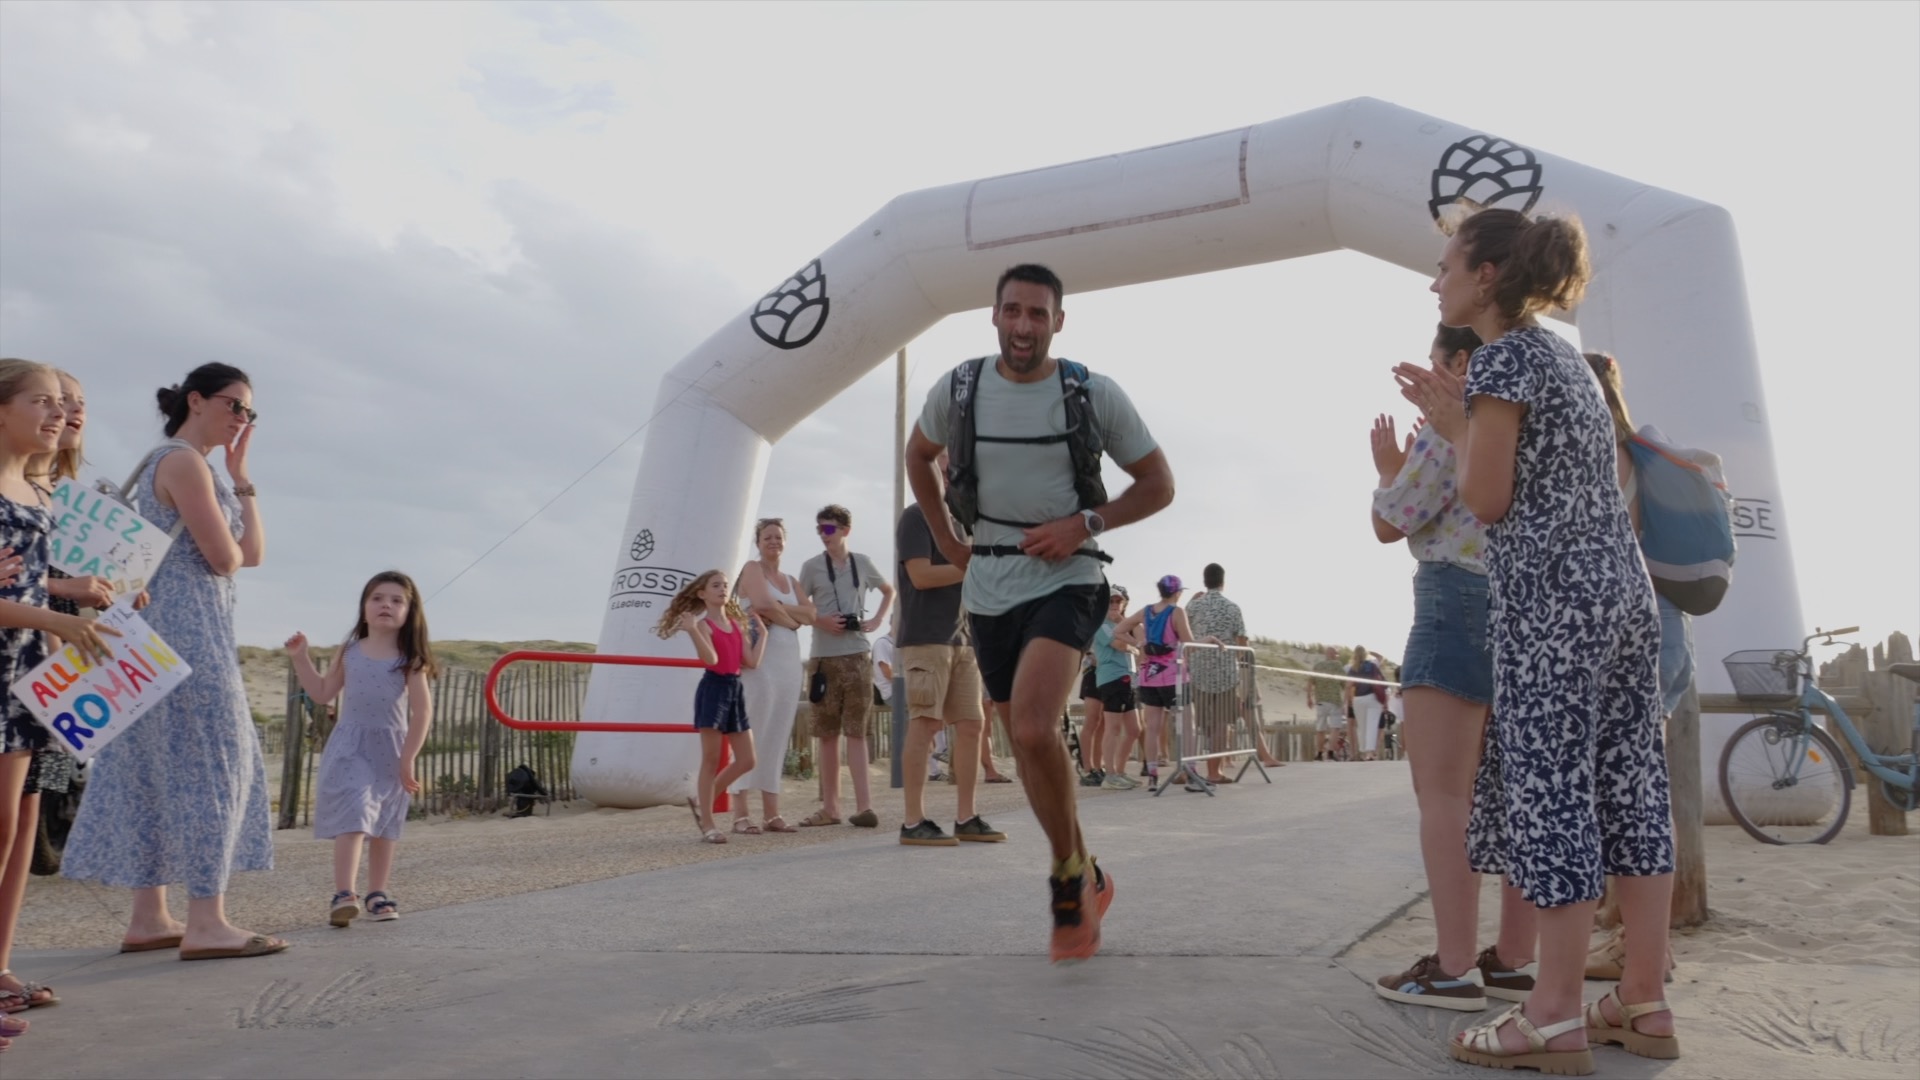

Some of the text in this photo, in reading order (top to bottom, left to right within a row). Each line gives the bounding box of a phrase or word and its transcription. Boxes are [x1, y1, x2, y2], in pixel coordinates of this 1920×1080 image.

[52, 484, 144, 544] ALLEZ
[58, 513, 92, 543] ES
[1733, 506, 1775, 532] SE
[52, 538, 116, 580] APAS
[612, 572, 692, 592] ROSS
[32, 647, 104, 708] ALLE
